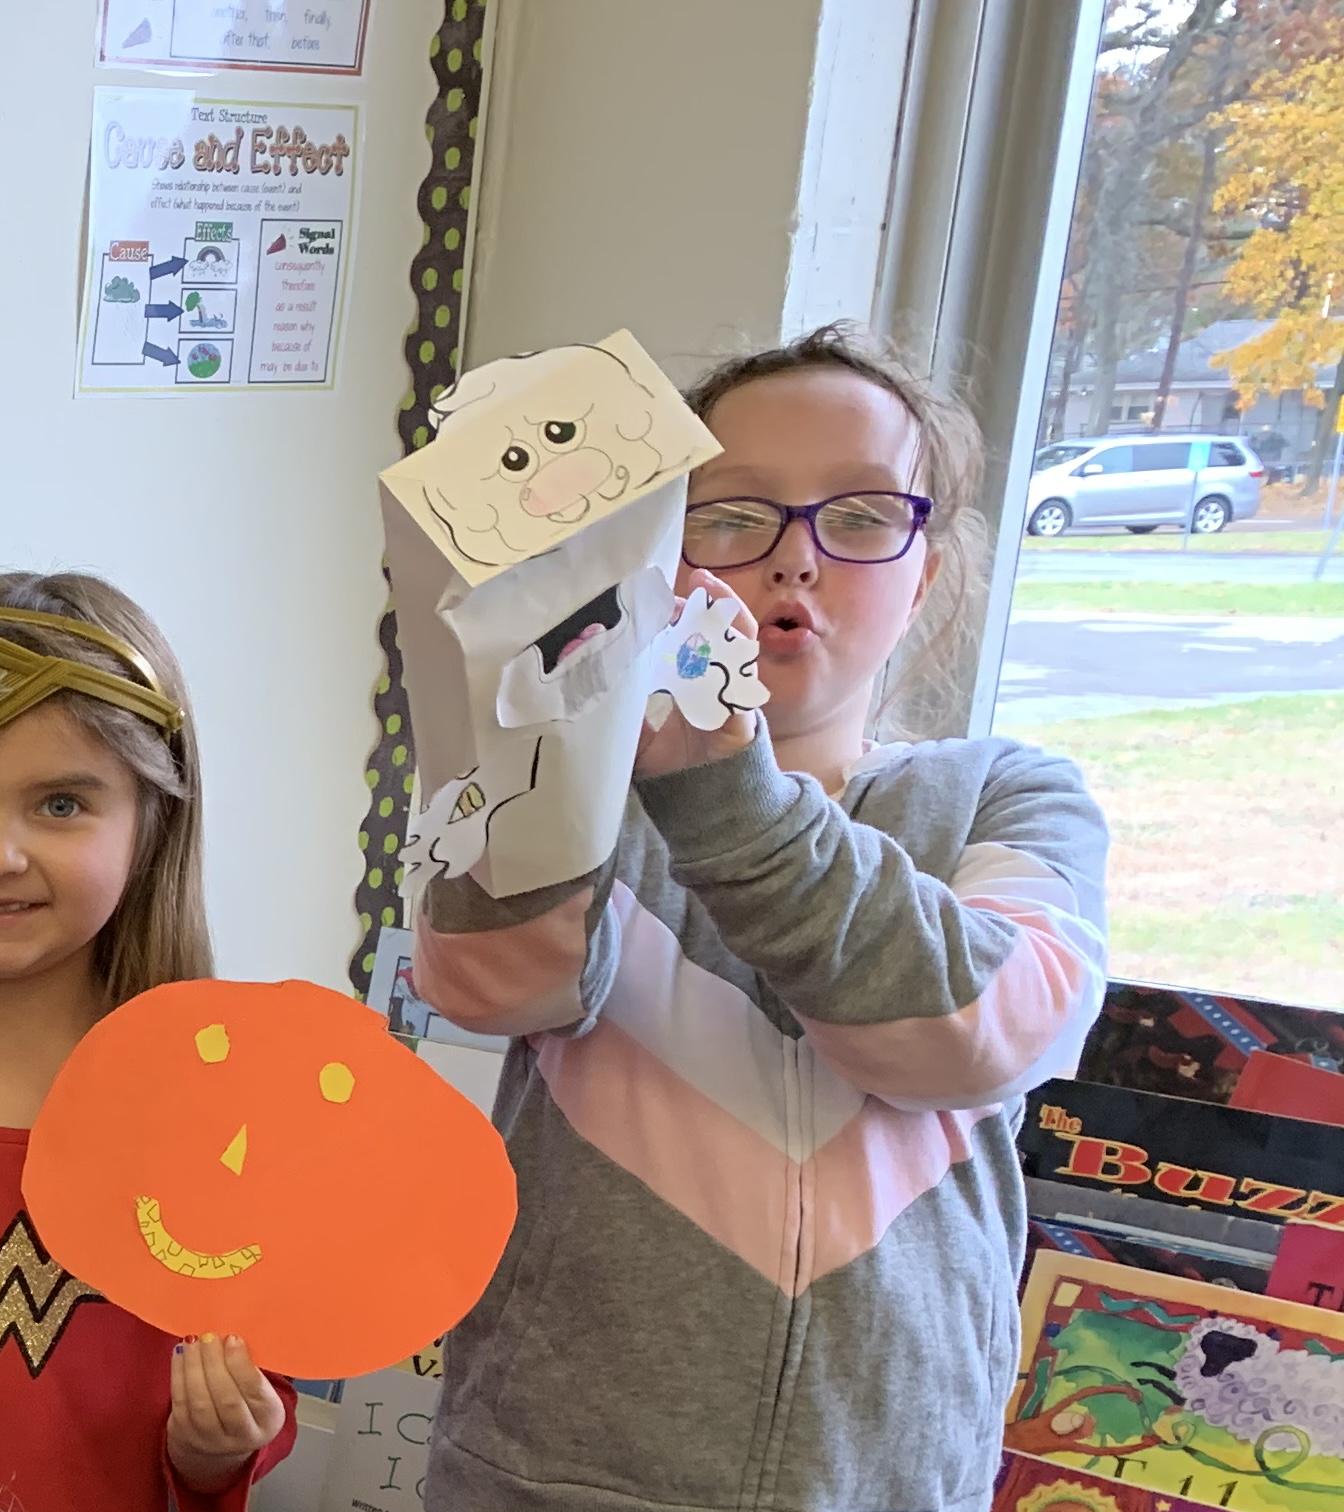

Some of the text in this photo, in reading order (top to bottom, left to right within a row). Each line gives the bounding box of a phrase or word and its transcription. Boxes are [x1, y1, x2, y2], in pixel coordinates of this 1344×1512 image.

[191, 107, 268, 124] Text Structure
[105, 121, 350, 176] Cause and Effect
[196, 223, 233, 241] Effects
[299, 228, 335, 242] Signal
[110, 243, 149, 261] Cause
[299, 243, 335, 255] Words
[1039, 1105, 1082, 1134] The
[357, 1402, 384, 1436] I
